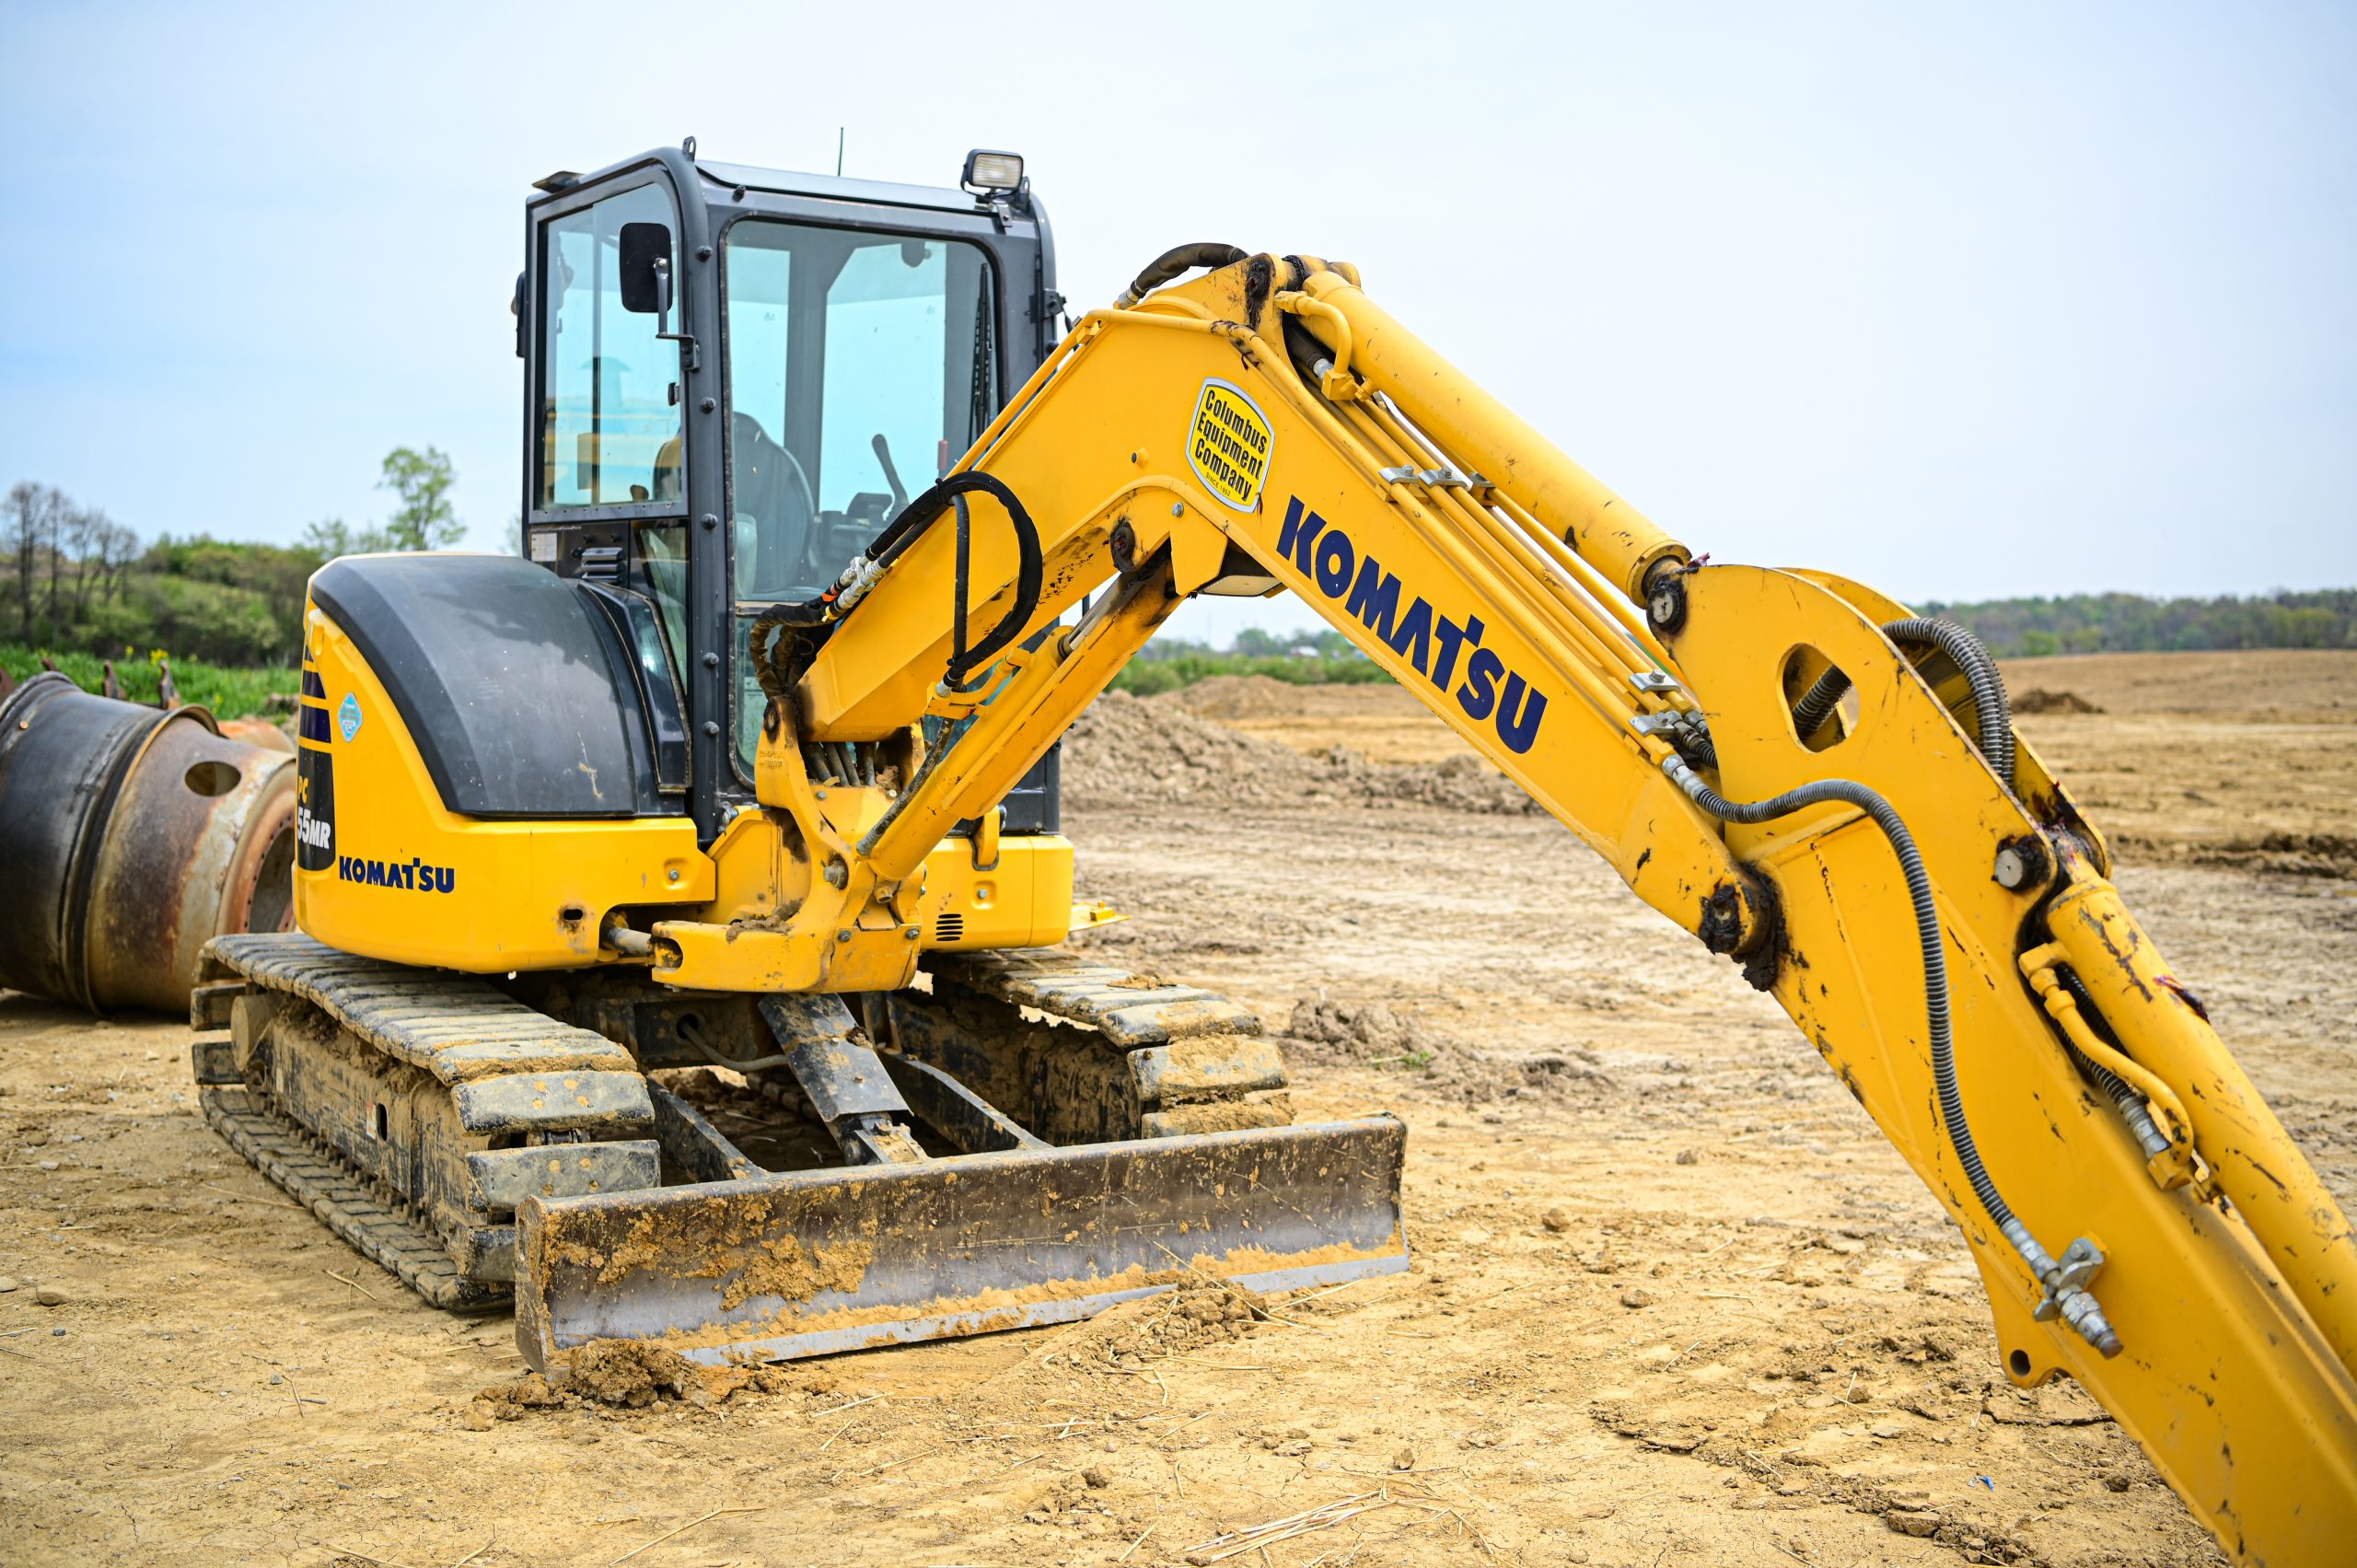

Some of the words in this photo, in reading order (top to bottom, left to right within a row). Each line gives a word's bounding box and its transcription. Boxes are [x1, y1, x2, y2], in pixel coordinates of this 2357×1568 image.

[1197, 411, 1263, 480] Equipment
[1205, 389, 1267, 454] Columbus
[1195, 437, 1252, 502] Company
[1205, 471, 1219, 489] SINCE
[1220, 485, 1231, 497] 1952
[1276, 494, 1549, 754] KOMATSU
[297, 775, 309, 804] PC
[296, 806, 331, 850] 55MR
[339, 855, 455, 894] KOMATSU
